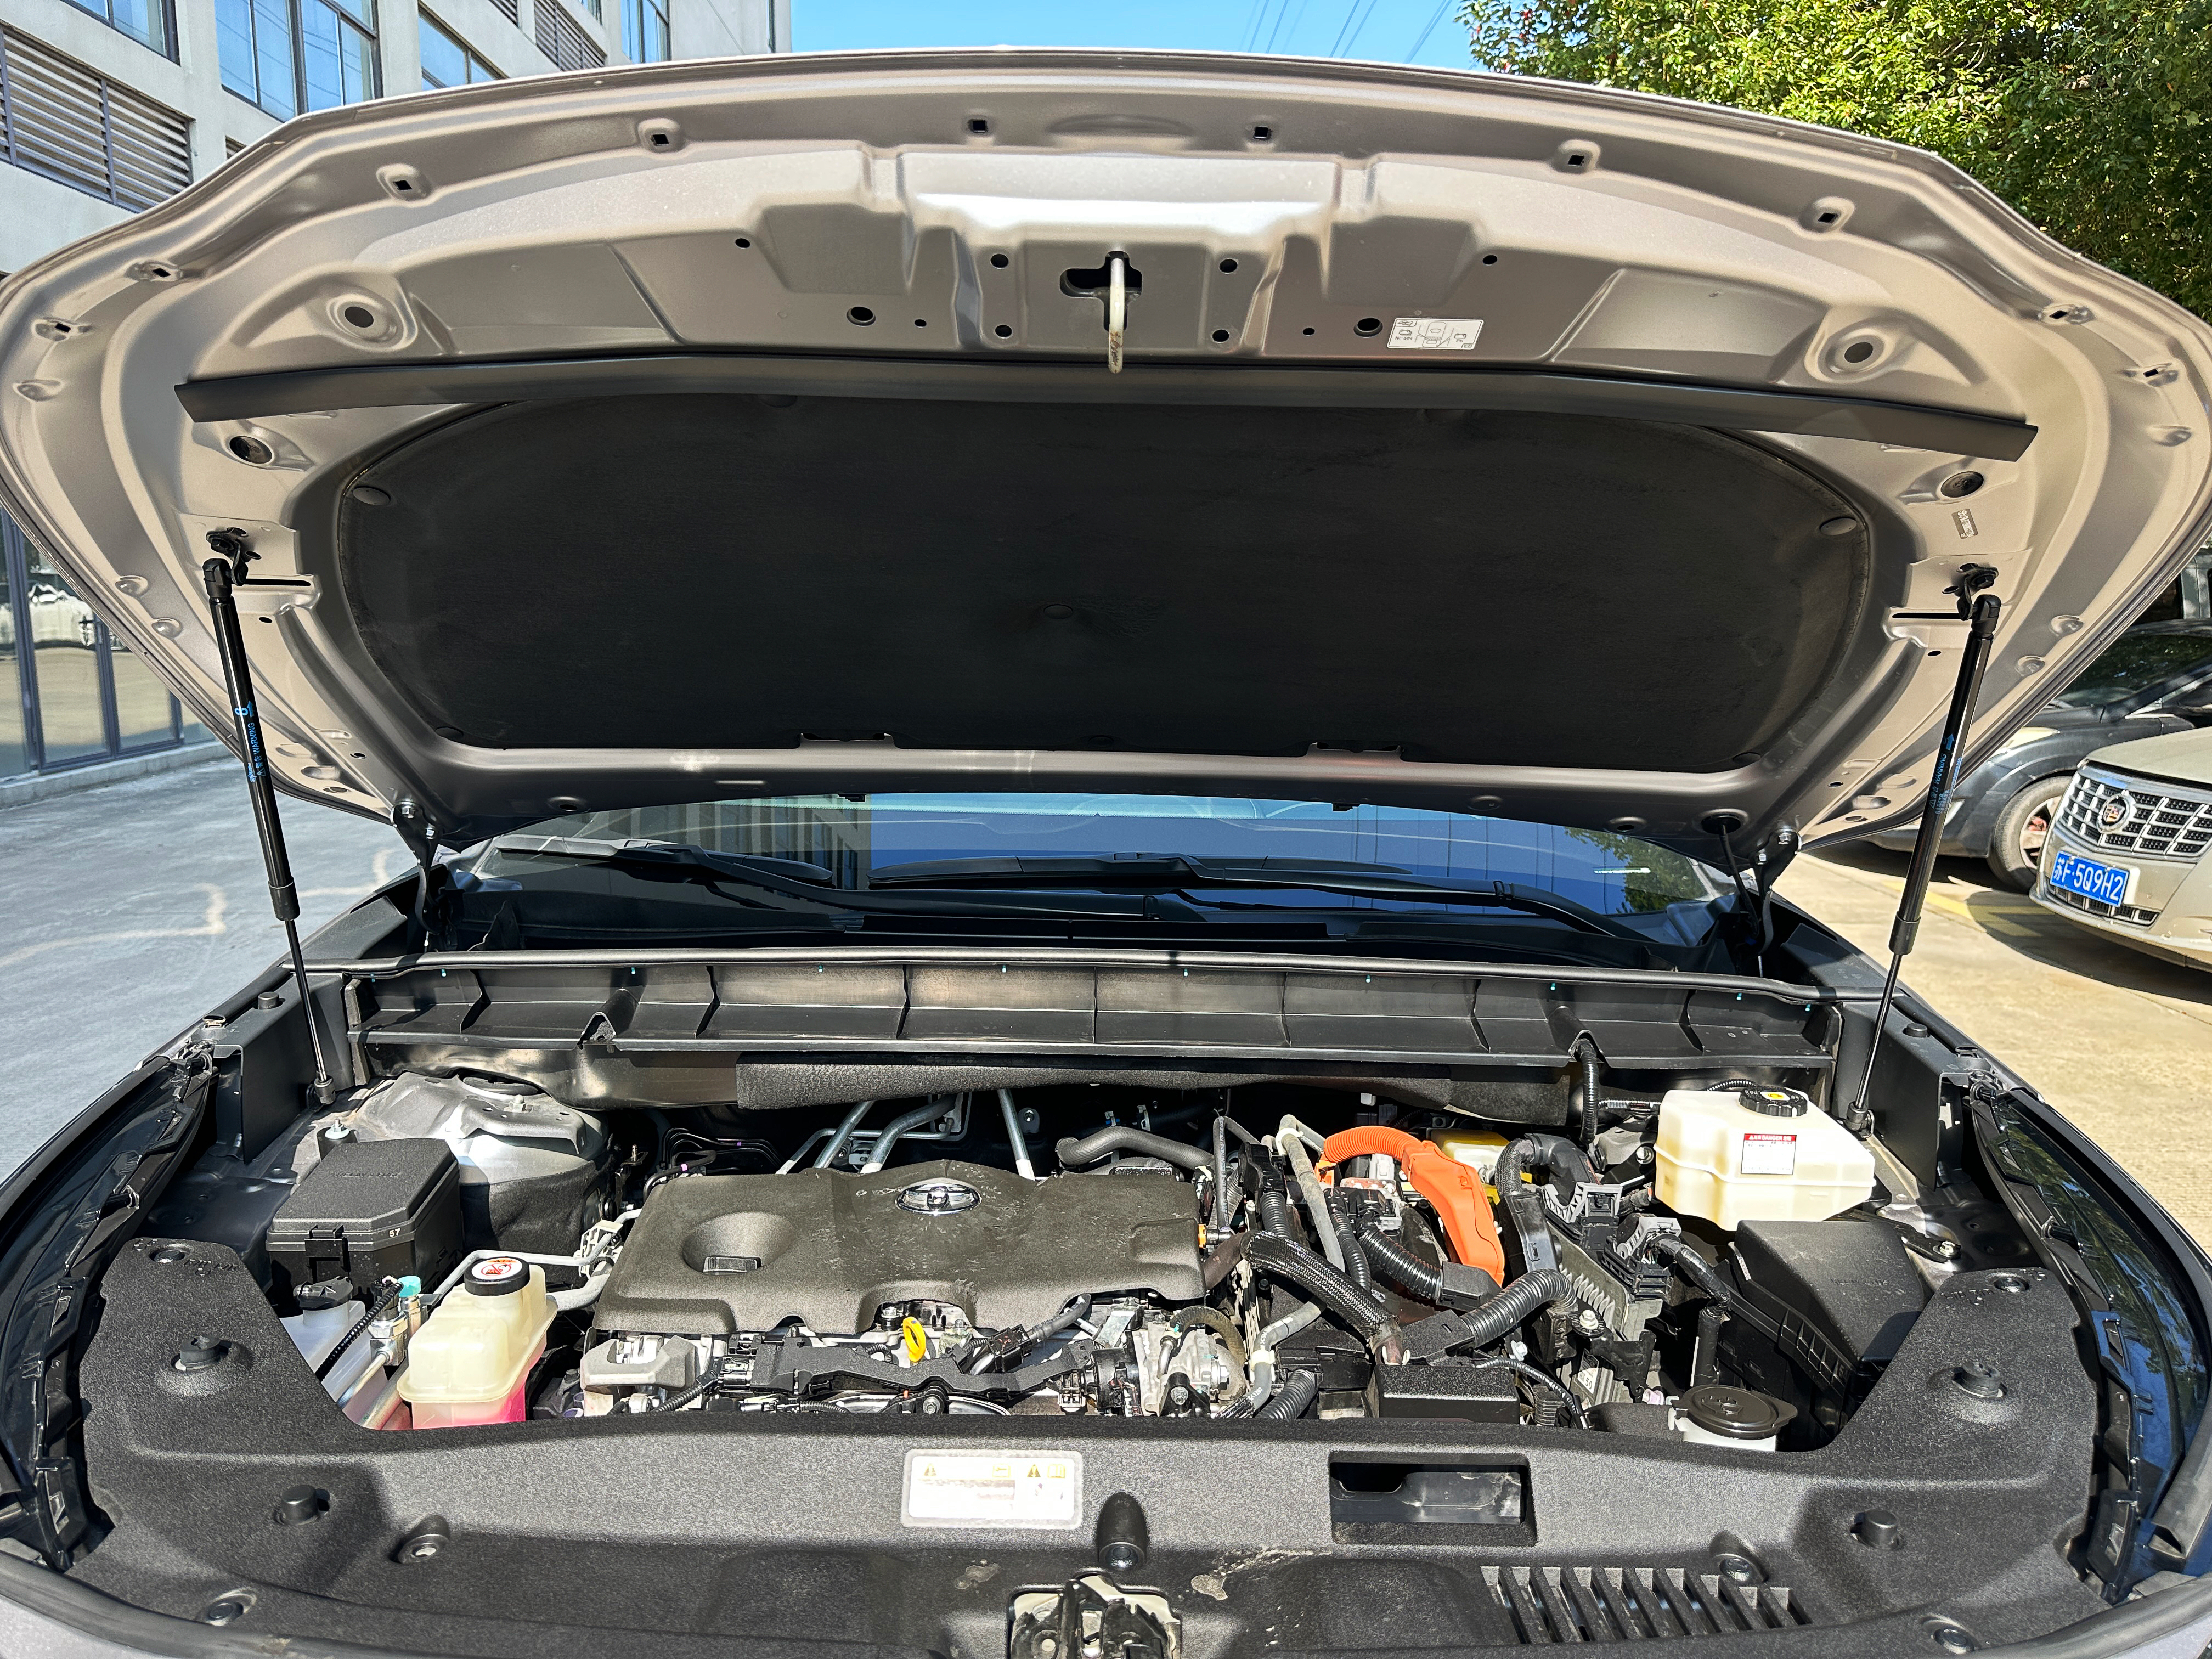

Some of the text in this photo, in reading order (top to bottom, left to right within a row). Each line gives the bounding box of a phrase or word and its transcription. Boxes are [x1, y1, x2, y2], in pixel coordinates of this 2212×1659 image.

[247, 722, 261, 755] WARNING
[1934, 753, 1947, 785] WARNING
[389, 1228, 400, 1237] 57
[1585, 1378, 1593, 1390] 50
